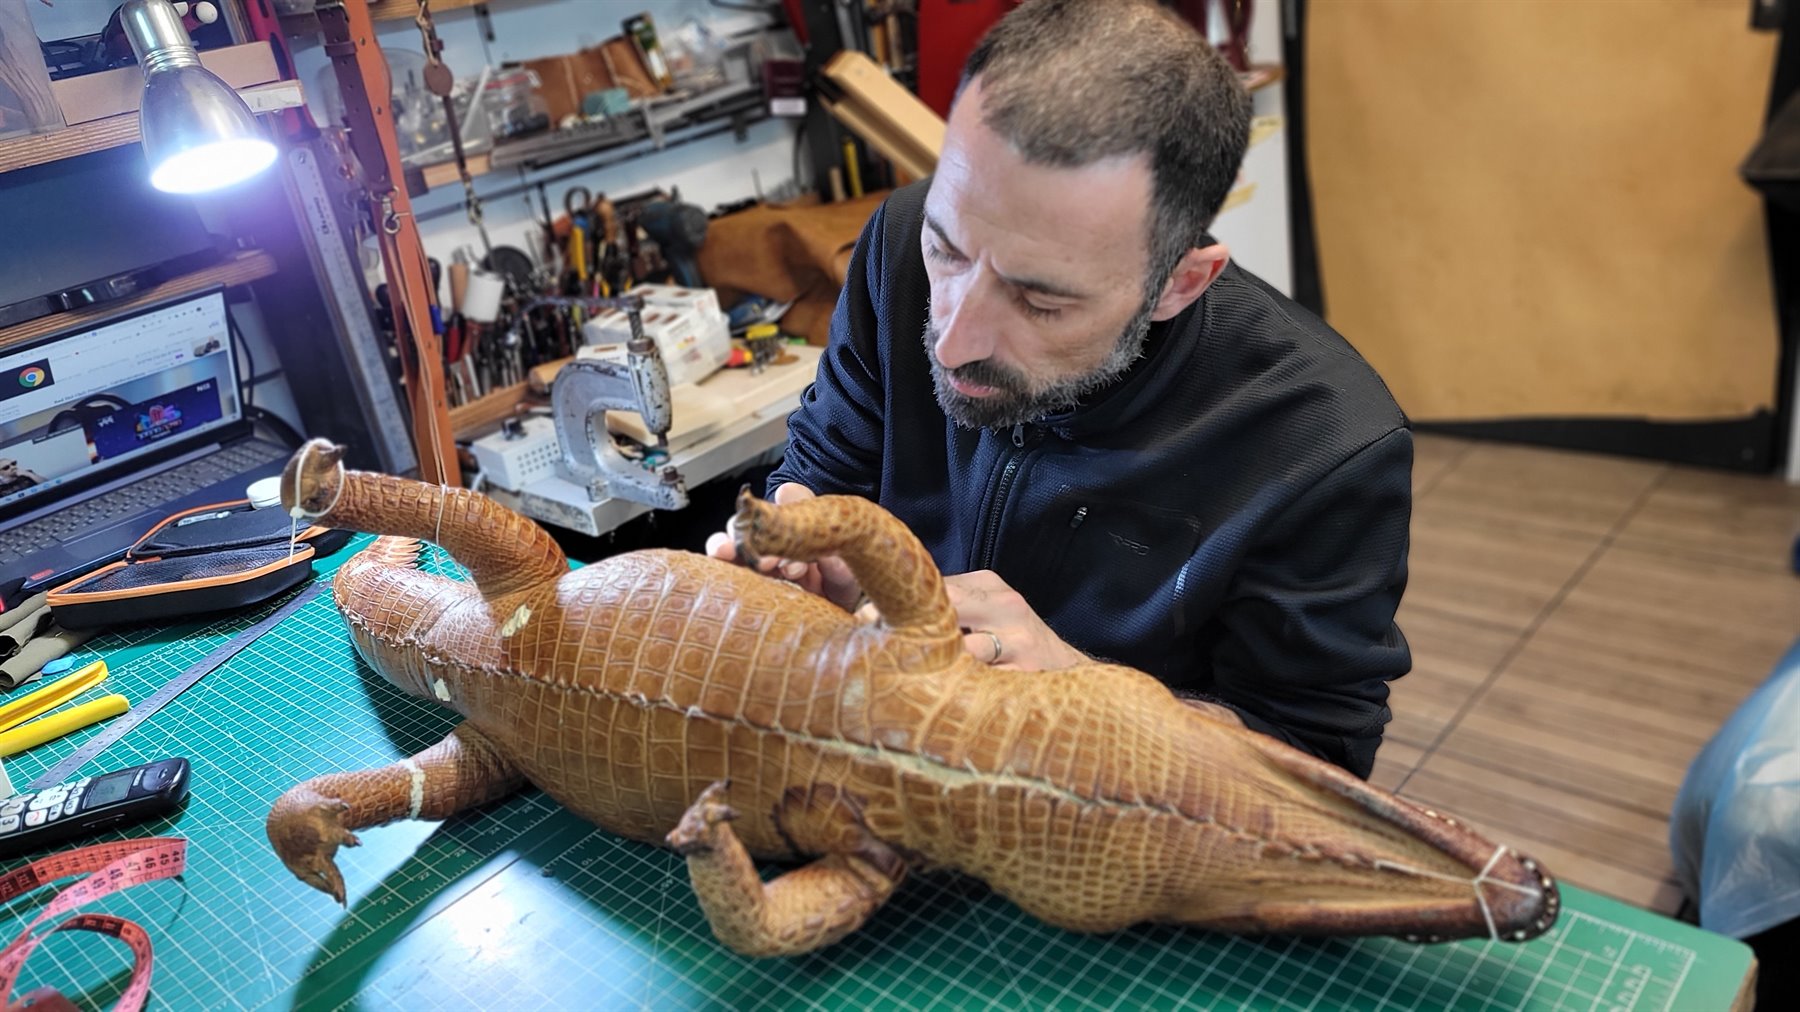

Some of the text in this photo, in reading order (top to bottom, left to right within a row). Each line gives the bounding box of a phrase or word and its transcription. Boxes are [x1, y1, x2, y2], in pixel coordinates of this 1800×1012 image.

[144, 856, 156, 869] 46
[160, 853, 170, 866] 45
[172, 850, 180, 863] 44
[342, 920, 355, 931] 20
[381, 896, 393, 906] 21
[418, 872, 431, 882] 22
[454, 849, 467, 858] 23
[489, 826, 501, 836] 24
